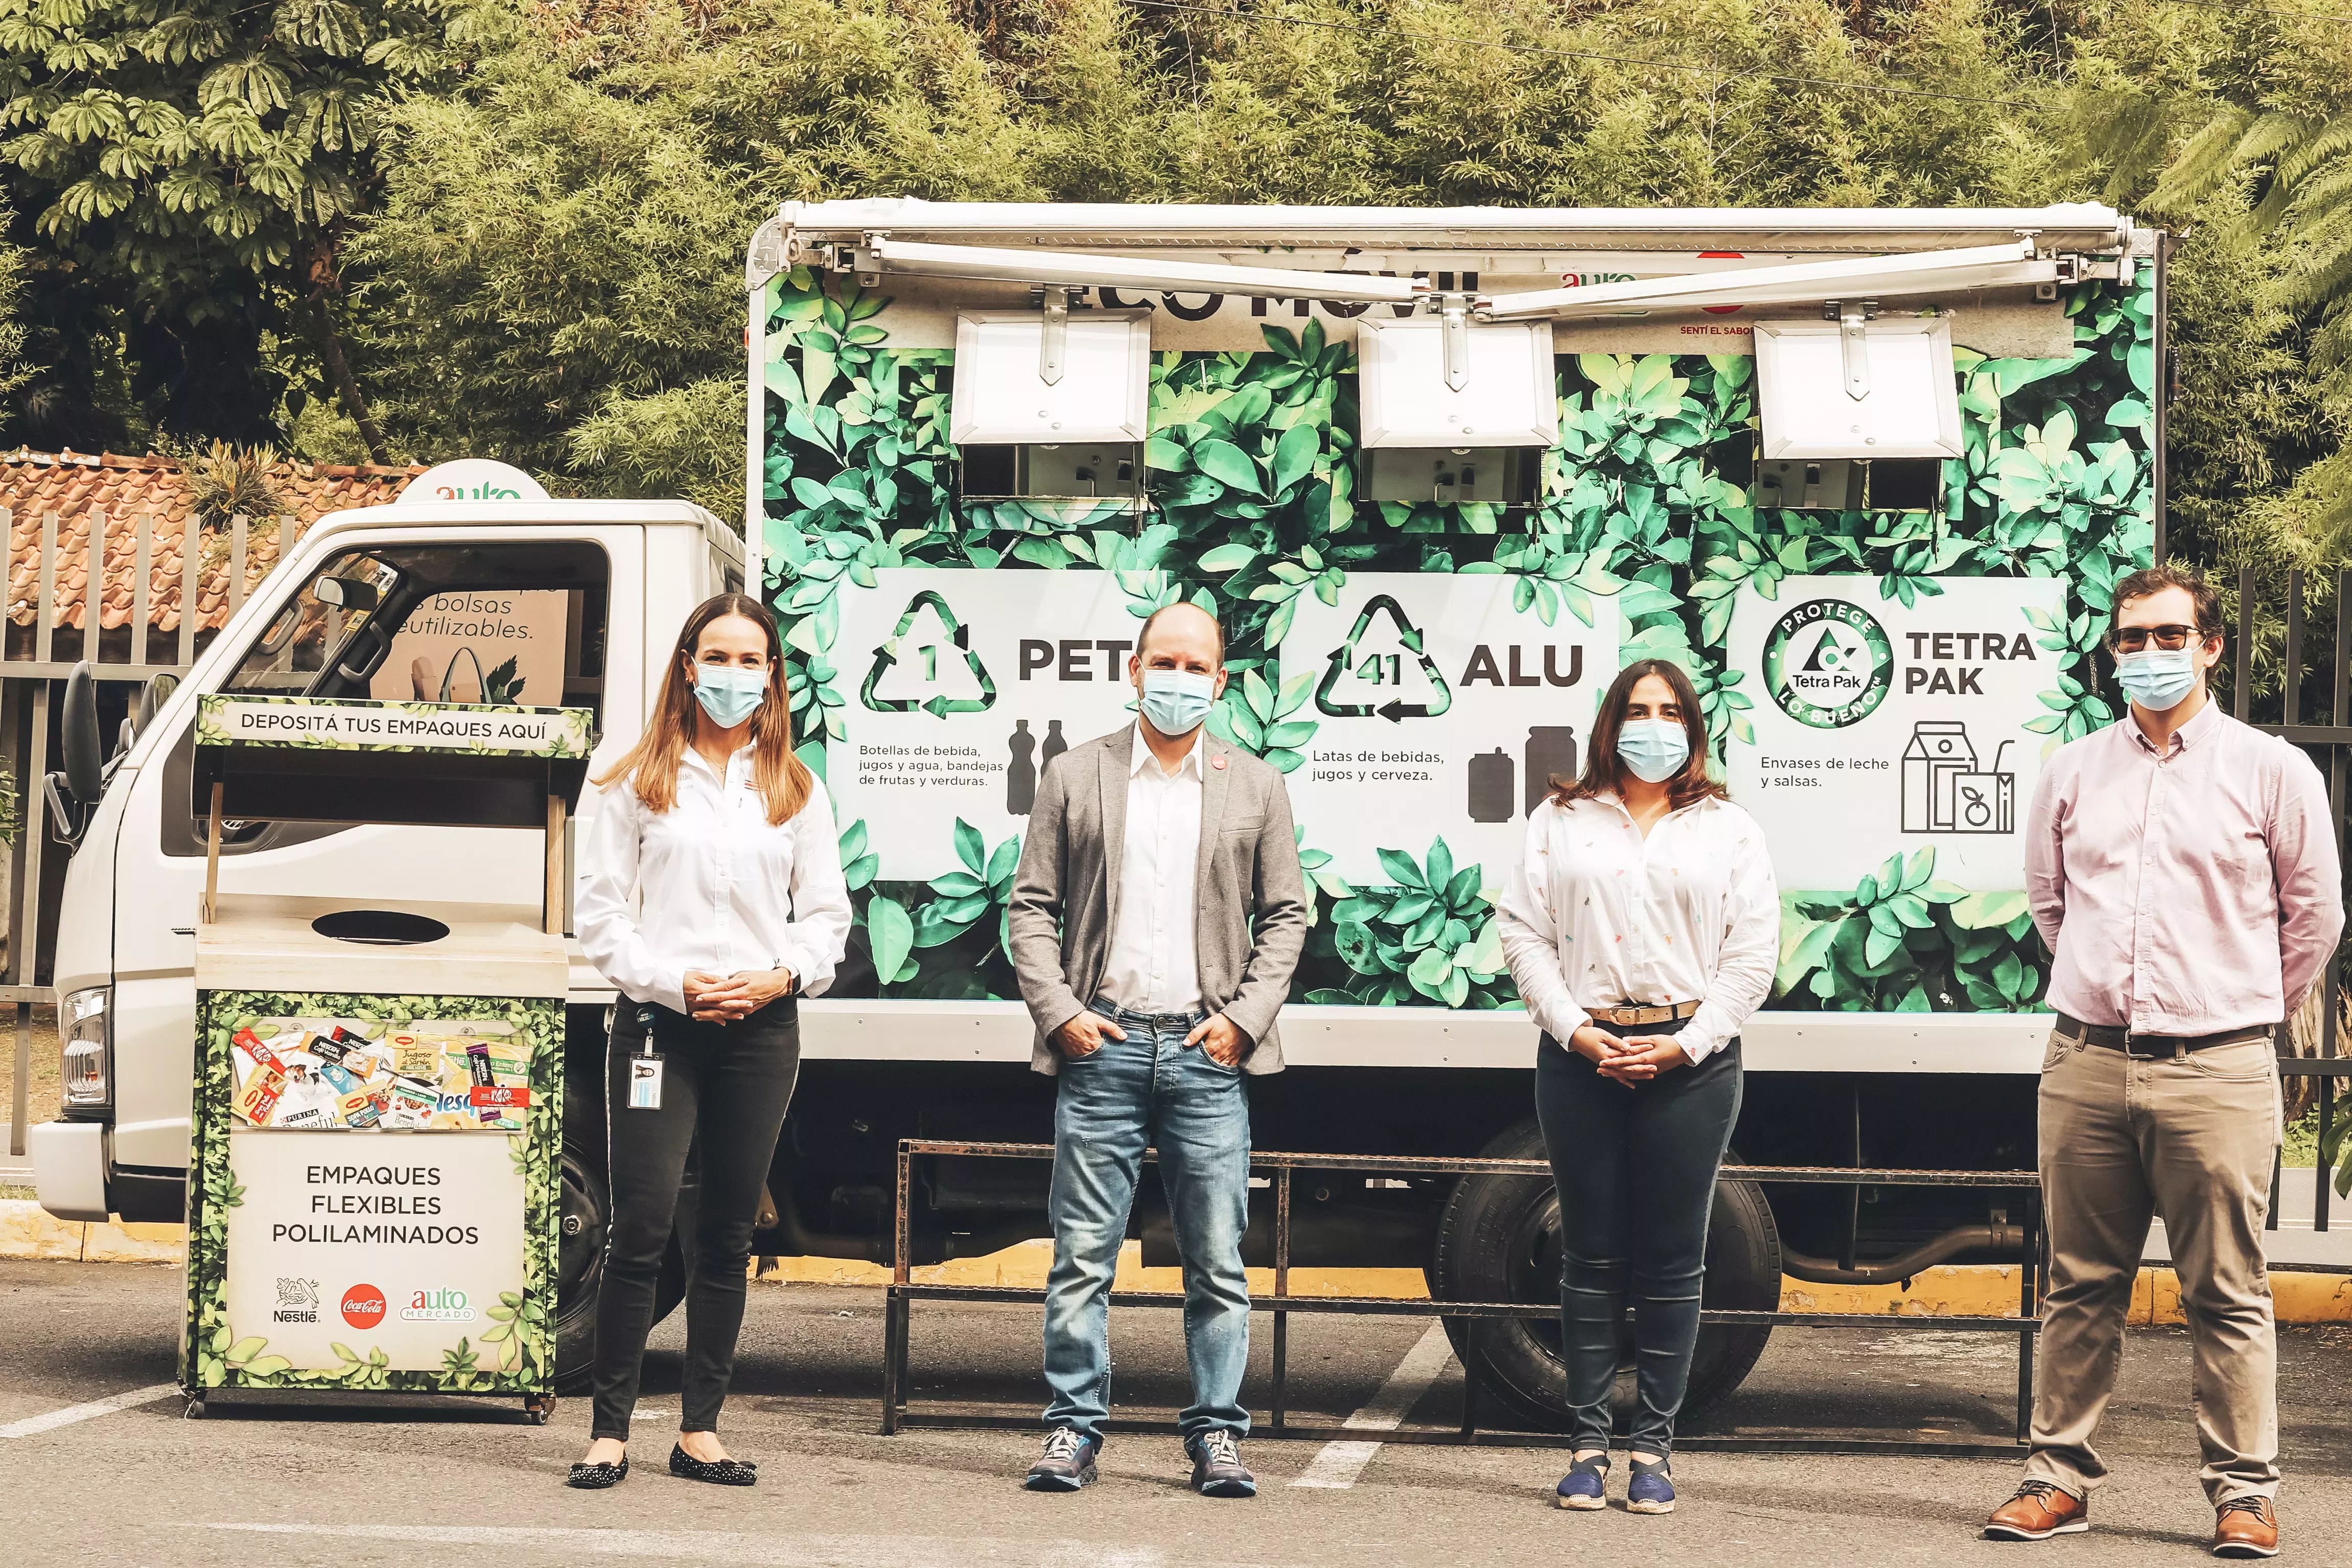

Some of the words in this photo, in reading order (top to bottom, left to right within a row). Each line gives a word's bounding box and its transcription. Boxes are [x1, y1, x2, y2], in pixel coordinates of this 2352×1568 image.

[1681, 325, 1708, 335] SENTÍ
[435, 594, 512, 614] bolsas
[398, 616, 533, 639] eutilizables.
[1781, 602, 1875, 634] PROTEGE
[1906, 633, 2038, 661] TETRA
[918, 645, 936, 681] 1
[1020, 639, 1132, 681] PET
[1357, 654, 1401, 685] 41
[1459, 645, 1582, 687] ALU
[1792, 674, 1829, 688] Tetra
[1833, 675, 1861, 689] Pak
[1905, 667, 1984, 695] PAK
[1778, 691, 1803, 714] LO
[242, 714, 337, 733] DEPOSITÁ
[345, 718, 381, 733] TUS
[388, 720, 492, 738] EMPAQUES
[498, 720, 546, 740] AQUÍ
[860, 745, 910, 755] Botellas
[914, 746, 929, 755] de
[934, 746, 980, 757] bebida,
[1313, 750, 1352, 762] Latas
[1358, 751, 1376, 762] de
[1382, 751, 1444, 764] bebidas,
[859, 760, 893, 771] jugos
[898, 762, 904, 771] y
[909, 762, 942, 772] agua,
[947, 761, 1003, 773] bandejas
[1761, 757, 1821, 768] Envases
[1826, 758, 1844, 769] de
[1850, 758, 1889, 769] leche
[859, 775, 875, 784] de
[879, 775, 915, 785] frutas
[920, 778, 926, 787] y
[931, 776, 988, 786] verduras.
[1312, 768, 1353, 782] jugos
[1358, 771, 1366, 782] y
[1371, 771, 1433, 781] cerveza.
[1761, 778, 1768, 788] y
[1775, 775, 1822, 787] salsas.
[403, 1050, 432, 1060] Jugoso
[288, 1110, 318, 1121] PURINA
[307, 1166, 440, 1185] EMPAQUES
[312, 1195, 441, 1214] FLEXIBLES
[273, 1224, 478, 1245] POLILAMINADOS
[343, 1299, 384, 1314] Coca-Cola
[411, 1287, 467, 1309] auto
[274, 1310, 317, 1323] Nestlé
[407, 1310, 471, 1318] MERCADO
